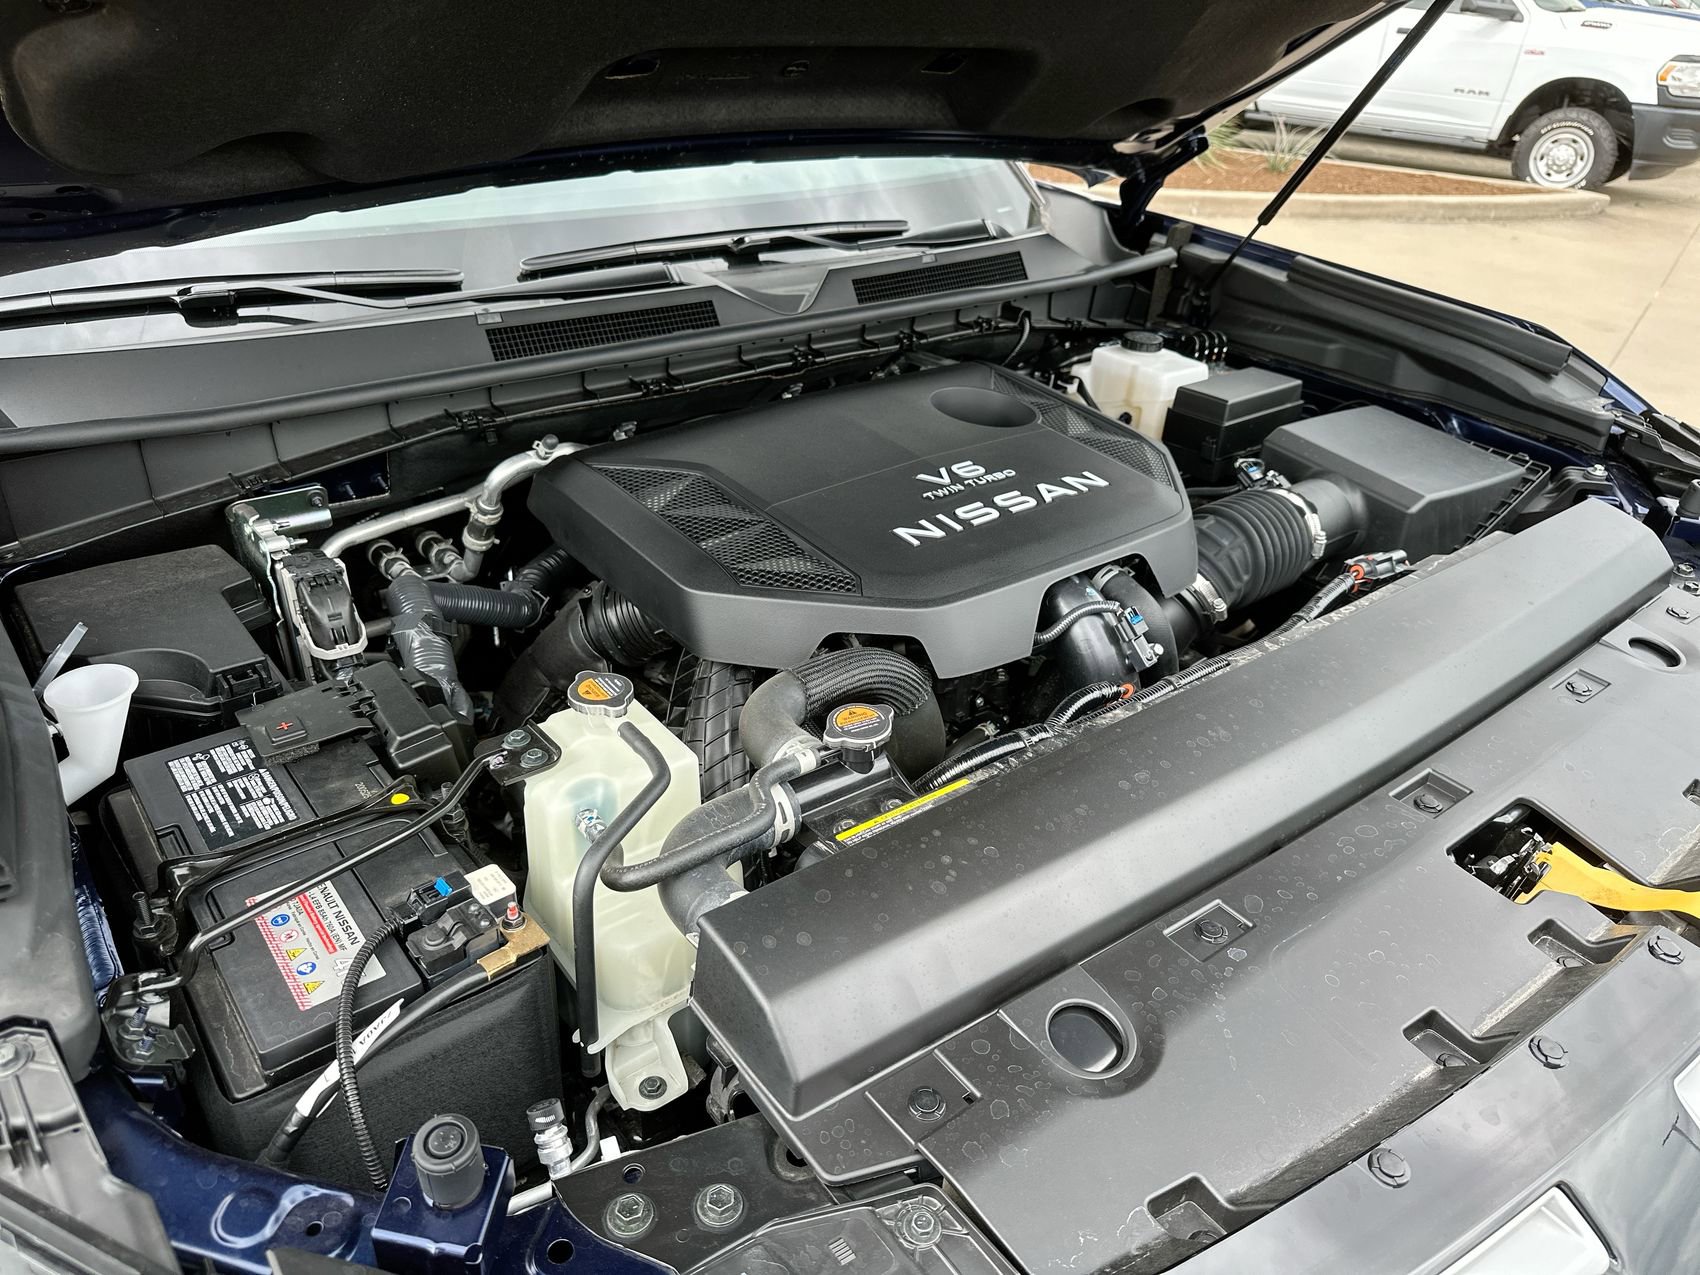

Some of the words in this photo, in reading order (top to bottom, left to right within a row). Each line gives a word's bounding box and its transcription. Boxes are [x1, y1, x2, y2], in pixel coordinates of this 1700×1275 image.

[1453, 88, 1490, 97] RAM
[915, 460, 986, 486] V6
[922, 483, 965, 501] TWIN
[963, 468, 1016, 488] TURBO
[892, 470, 1110, 547] NISSAN
[317, 883, 340, 909] ENAULT
[333, 910, 360, 945] NISSAN
